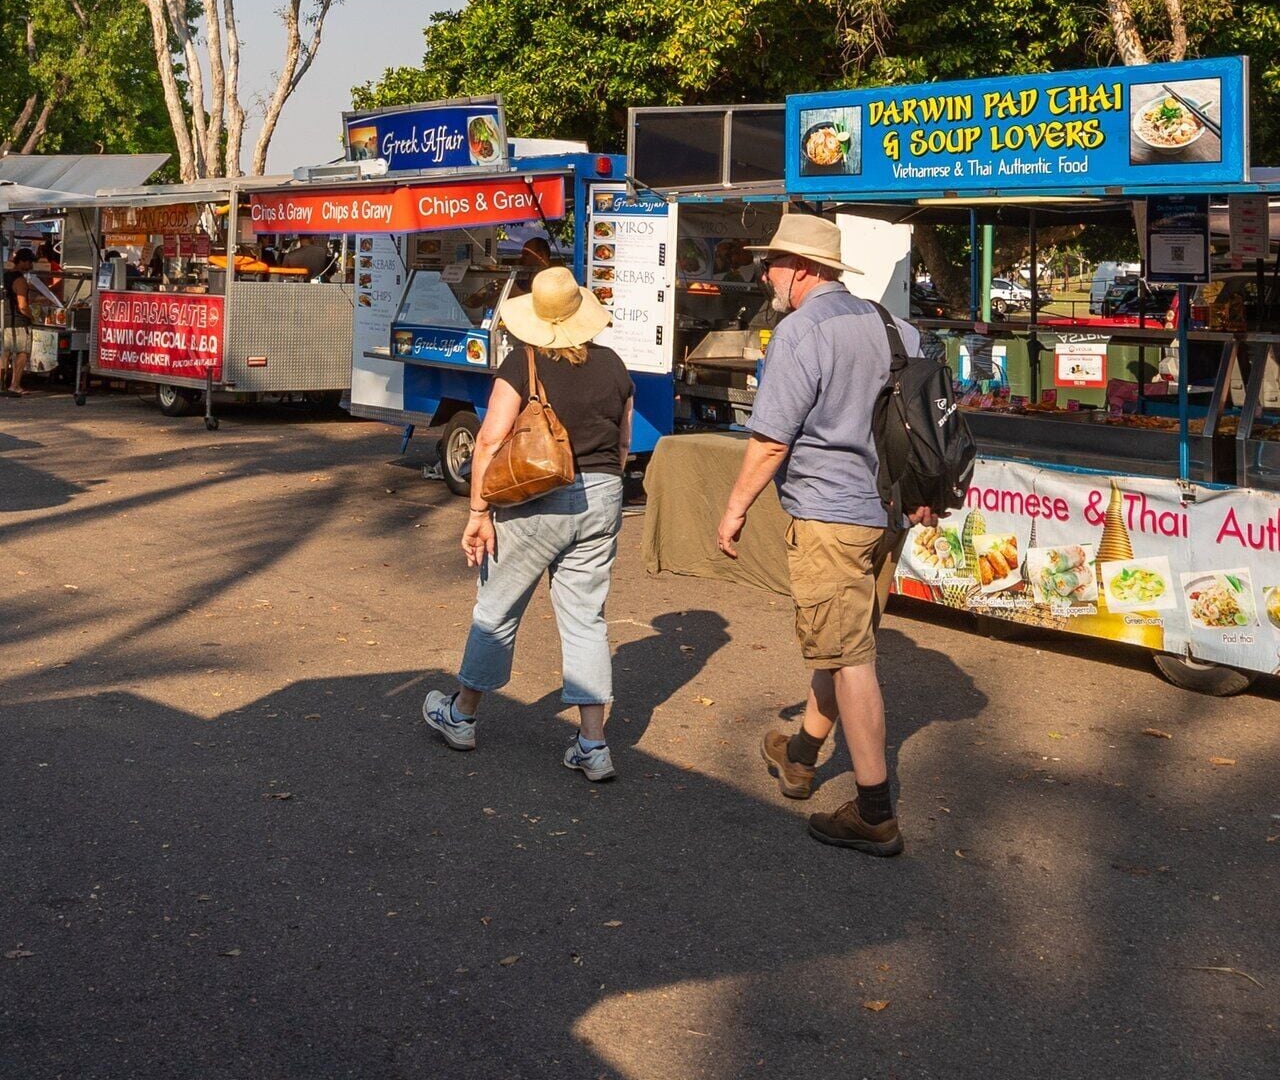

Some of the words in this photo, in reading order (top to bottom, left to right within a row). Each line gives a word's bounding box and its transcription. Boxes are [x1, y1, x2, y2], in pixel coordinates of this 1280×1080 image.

[868, 92, 978, 126] DARWIN
[983, 86, 1040, 119] PAD
[1046, 83, 1122, 115] THAI
[382, 126, 420, 163] Greek
[421, 126, 465, 162] Affair
[882, 131, 901, 160] &
[910, 125, 986, 155] SOUP
[989, 118, 1106, 152] LOVERS
[893, 161, 951, 180] Vietnamese
[953, 161, 964, 176] &
[967, 158, 993, 176] Thai
[997, 156, 1053, 176] Authentic
[1057, 155, 1089, 174] Food
[251, 203, 276, 222] Chips
[278, 204, 285, 218] &
[286, 203, 313, 224] Gravy
[322, 201, 350, 223] Chips
[352, 201, 359, 219] &
[361, 201, 393, 224] Gravy
[418, 194, 470, 222] Chips
[475, 193, 489, 210] &
[493, 190, 543, 212] Gravy
[616, 221, 654, 235] YIROS
[371, 259, 396, 271] KEBABS
[616, 270, 655, 284] KEBABS
[371, 290, 392, 303] CHIPS
[102, 300, 130, 323] SARI
[614, 308, 649, 322] CHIPS
[415, 336, 438, 355] Greek
[438, 339, 465, 357] Affair
[966, 486, 1070, 522] namese
[1083, 490, 1107, 527] &
[1123, 492, 1188, 538] Thai
[1124, 616, 1146, 625] Green
[1147, 617, 1164, 626] curry
[1222, 633, 1237, 642] Pad
[1240, 634, 1254, 643] thai
